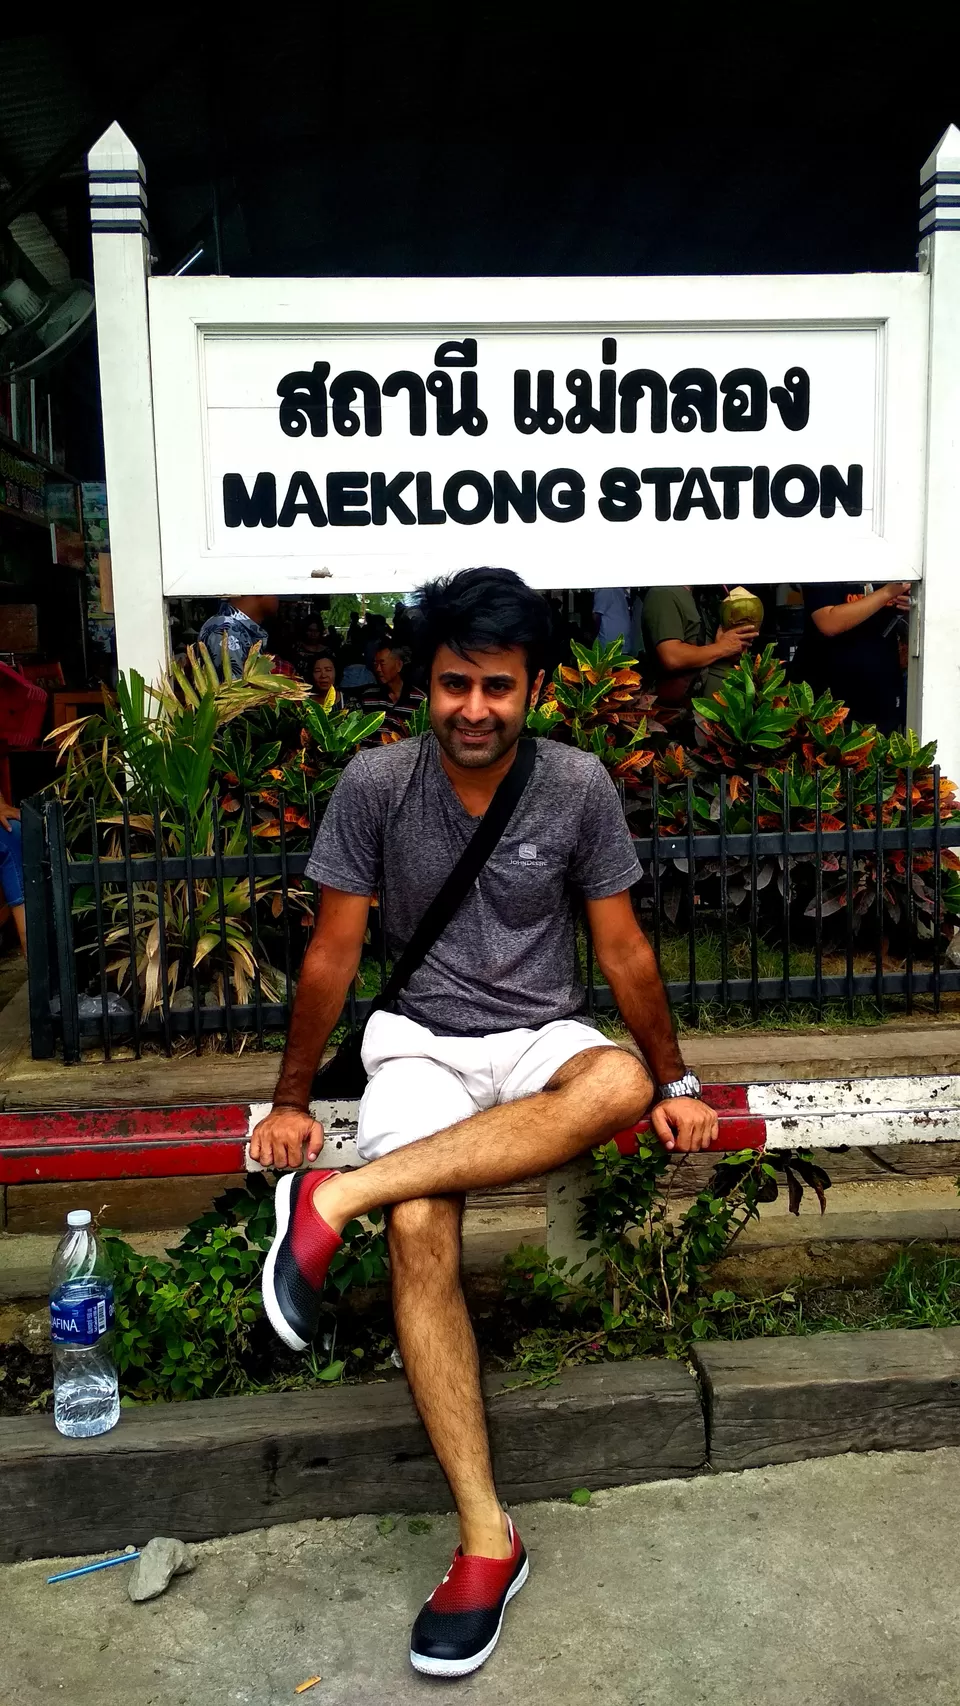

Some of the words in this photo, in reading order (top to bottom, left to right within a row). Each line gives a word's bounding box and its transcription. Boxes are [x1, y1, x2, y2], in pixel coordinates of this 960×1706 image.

[277, 338, 488, 437] สถานี
[514, 338, 810, 435] แม่กลอง
[223, 468, 585, 528] MAEKLONG
[598, 464, 863, 522] STATION
[51, 1316, 80, 1333] AFINA
